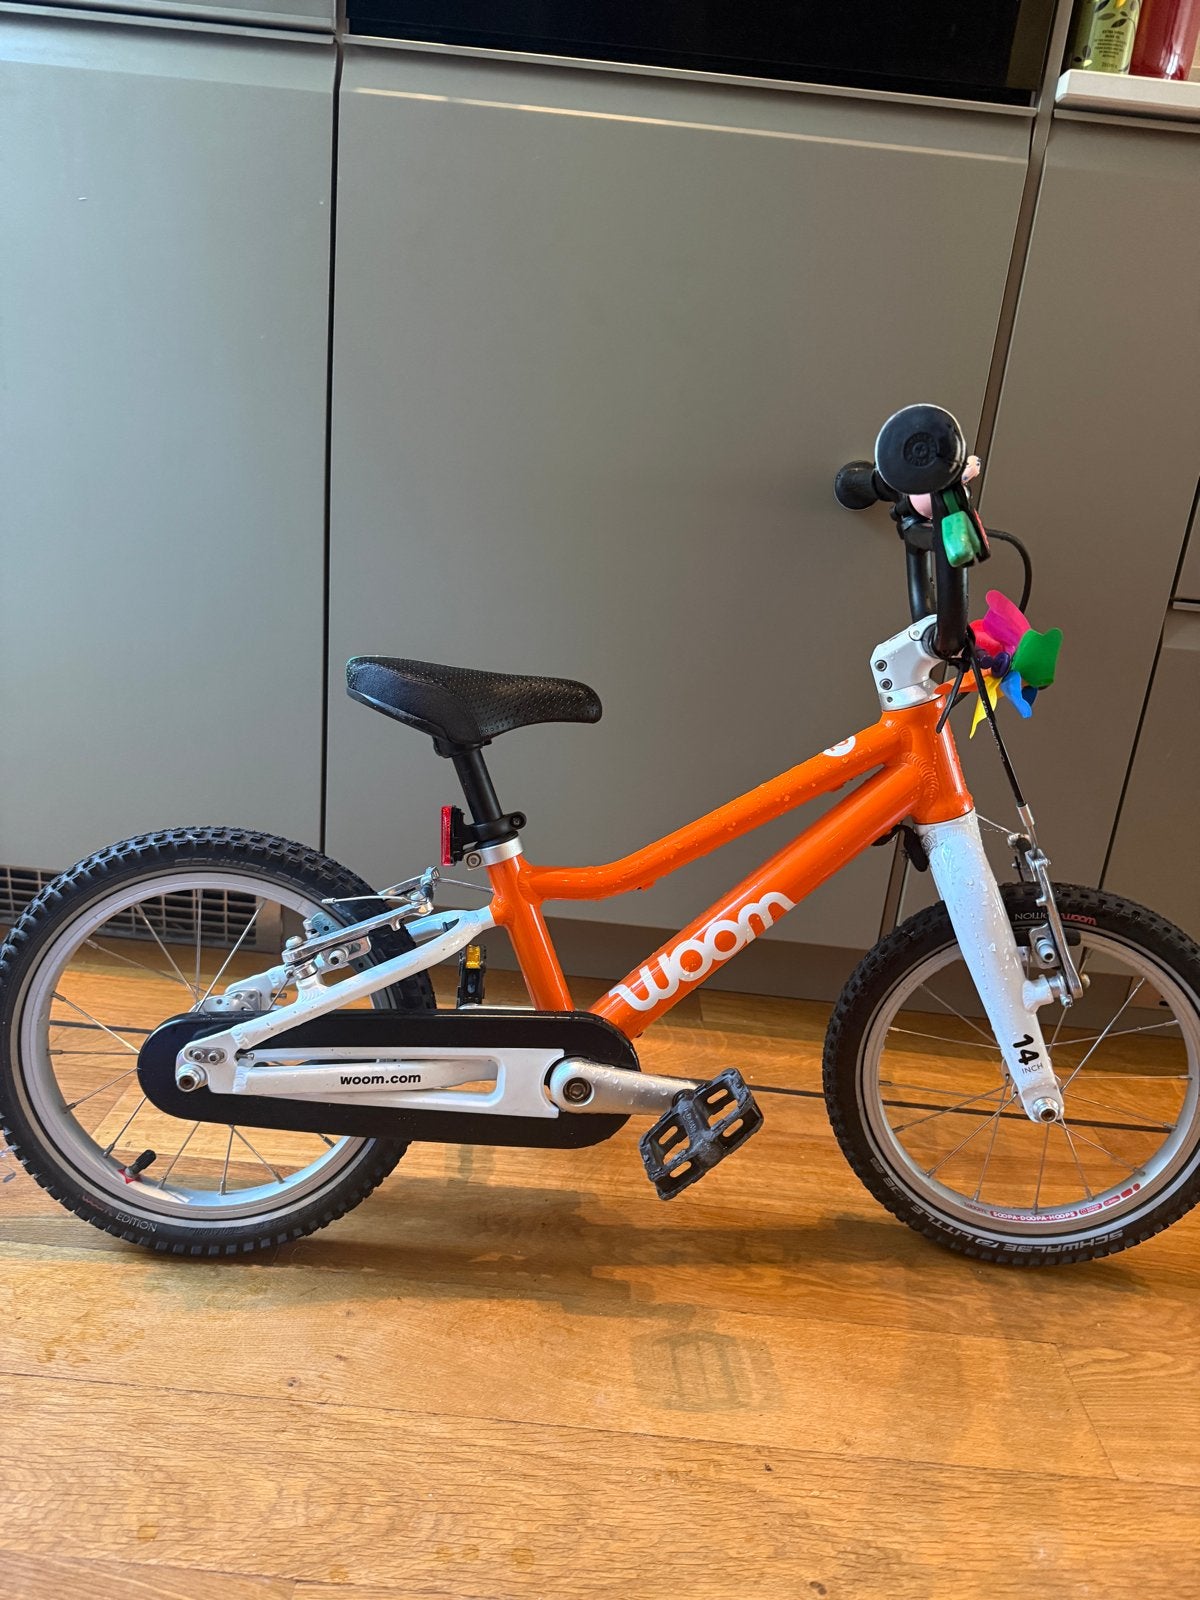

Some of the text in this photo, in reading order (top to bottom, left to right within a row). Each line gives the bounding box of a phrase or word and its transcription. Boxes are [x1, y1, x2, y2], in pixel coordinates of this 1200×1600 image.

[608, 892, 798, 1012] woom
[1012, 1033, 1040, 1066] 14
[340, 1074, 422, 1085] woom.com
[1021, 1062, 1044, 1074] INCH
[115, 1212, 158, 1233] EDITION
[910, 1205, 974, 1242] LITTLE
[1003, 1229, 1124, 1253] SCHWALBE
